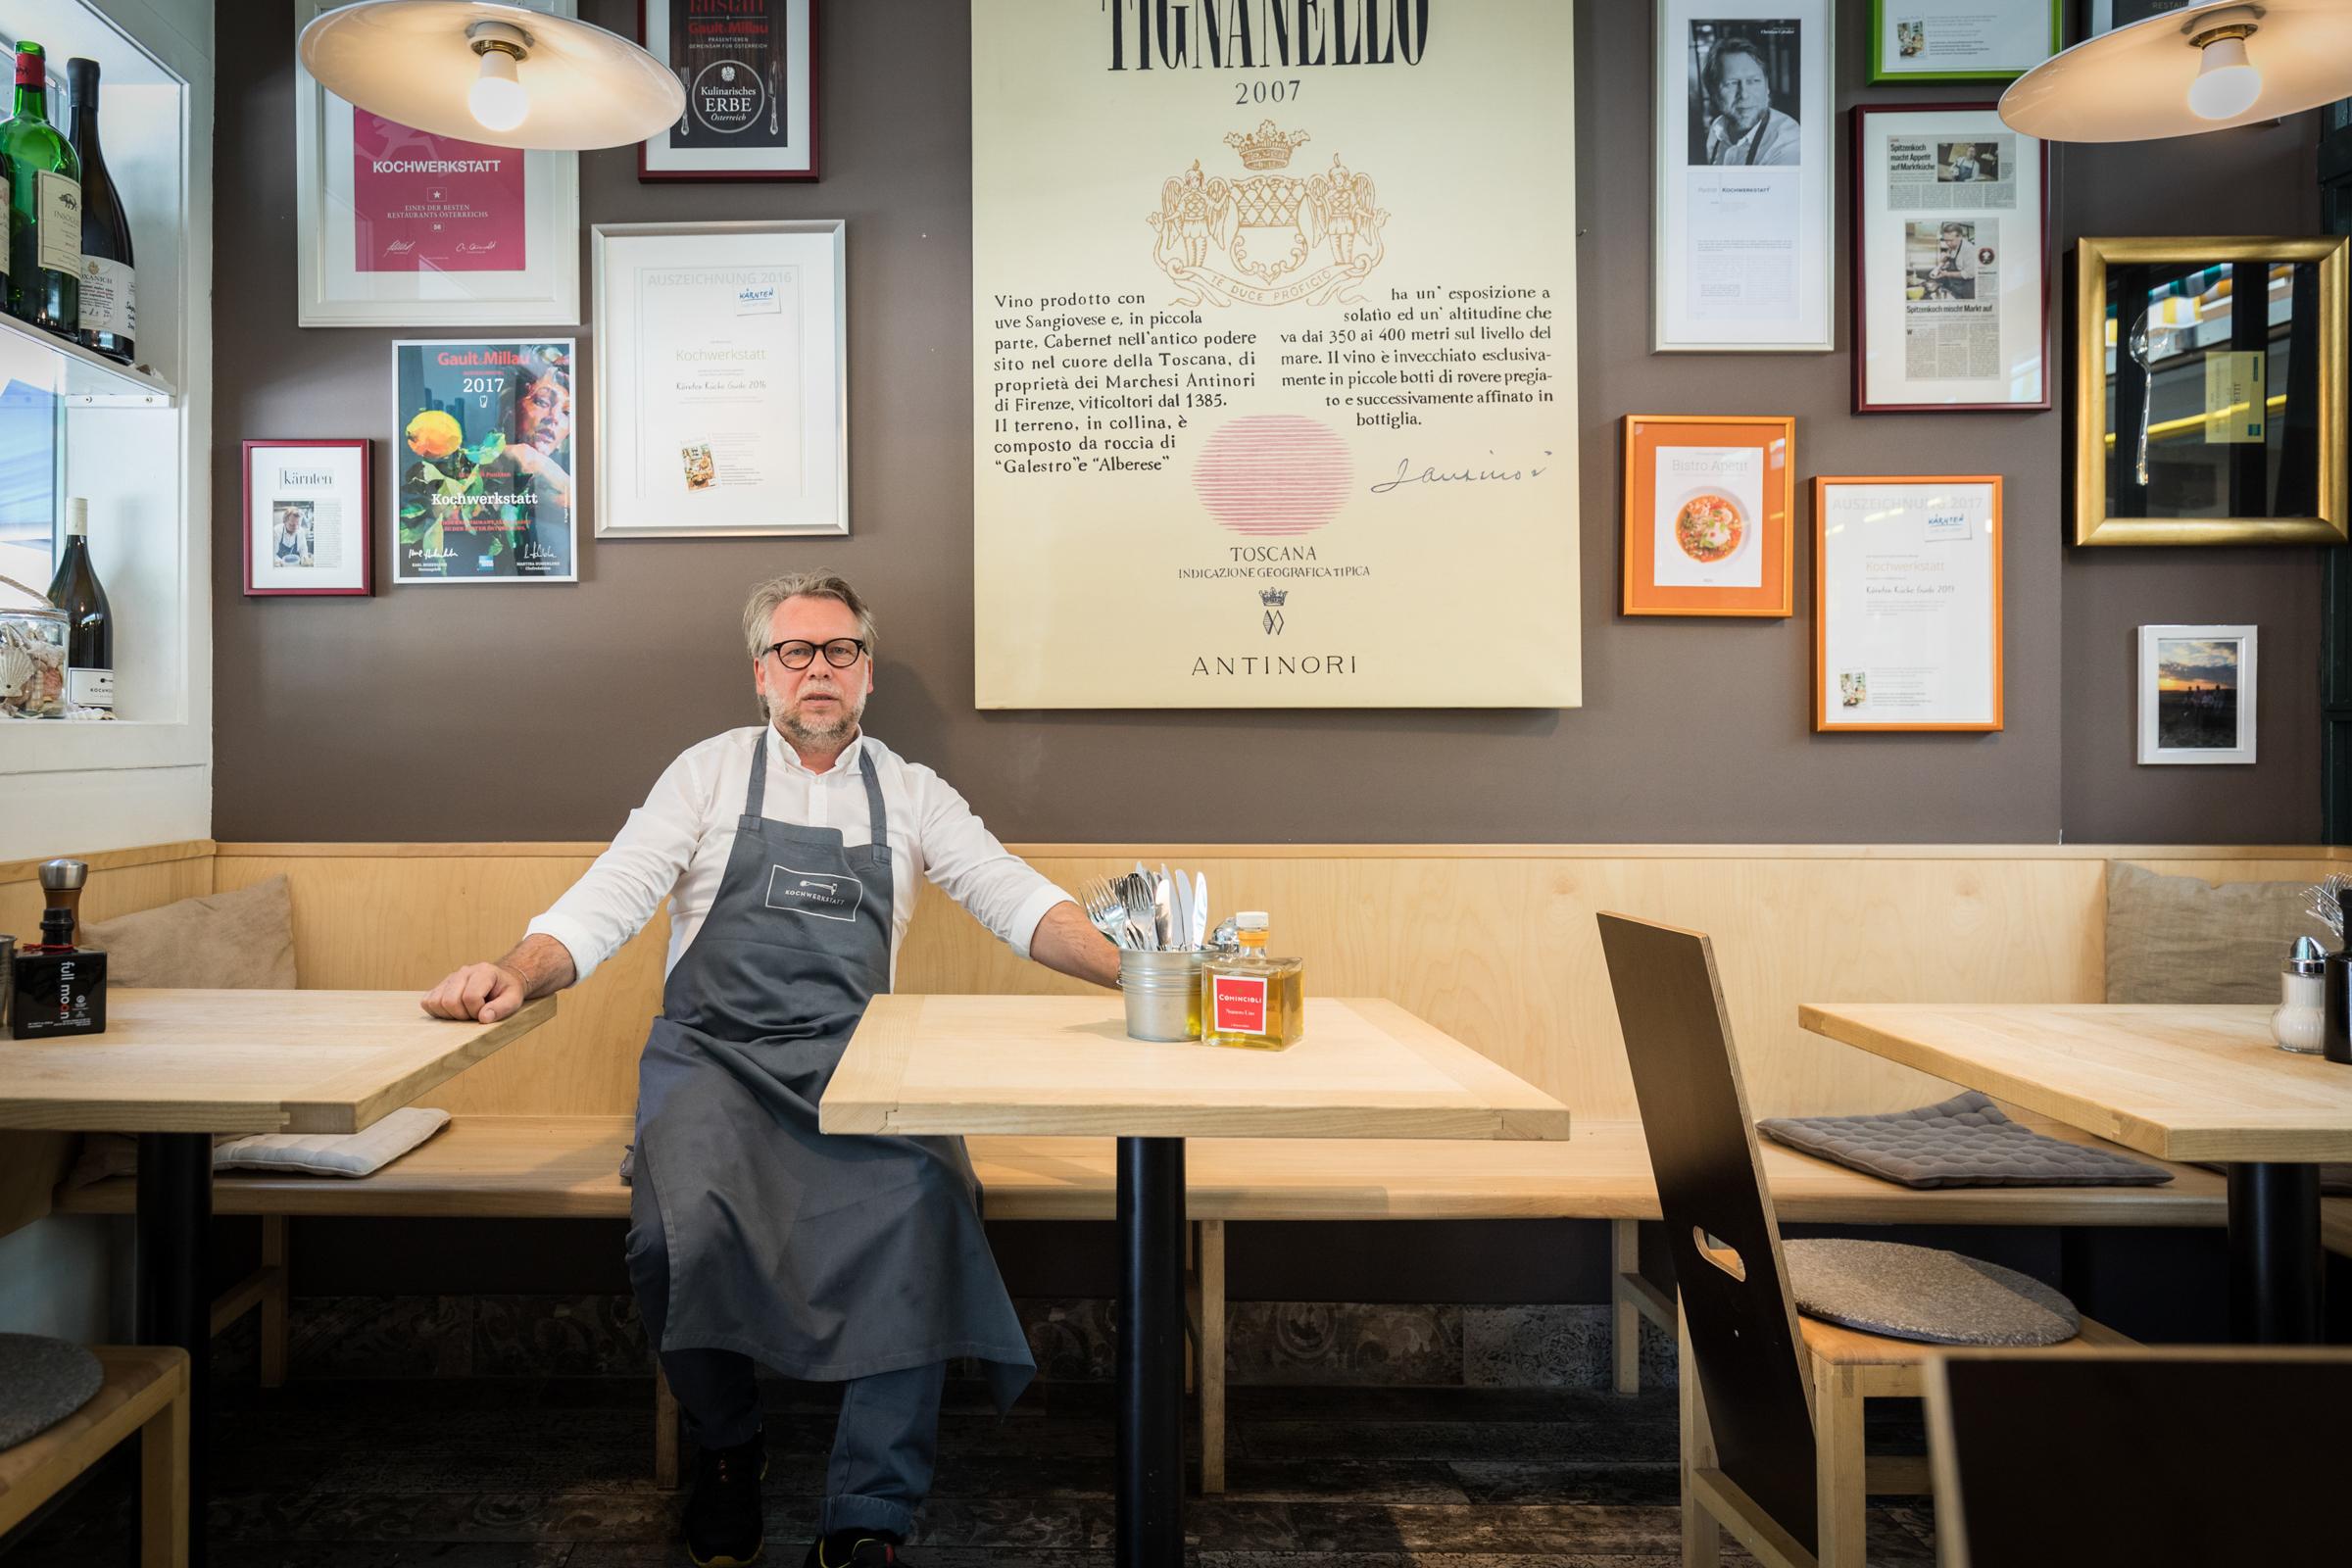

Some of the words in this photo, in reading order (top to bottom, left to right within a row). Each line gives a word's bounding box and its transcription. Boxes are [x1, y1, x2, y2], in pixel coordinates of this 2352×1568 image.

[701, 86, 757, 95] Kulinarisches
[1235, 79, 1301, 106] 2007
[706, 98, 752, 113] ERBE
[372, 160, 501, 173] KOCHWERKSTATT
[1910, 153, 1931, 162] Appetit
[649, 272, 759, 286] AUSZEICHNUNG
[760, 272, 792, 283] 2016
[1210, 275, 1224, 288] TE
[1231, 285, 1263, 302] DUCE
[1273, 270, 1332, 301] PROFICIO
[994, 294, 1034, 309] Vino
[1040, 291, 1111, 311] prodotto
[1117, 294, 1146, 305] con
[1391, 287, 1408, 301] ha
[1447, 284, 1537, 304] esposizione
[1542, 289, 1551, 299] a
[995, 318, 1022, 330] uve
[1025, 313, 1106, 332] Sangiovese
[1129, 312, 1145, 325] in
[1150, 309, 1203, 330] piccola
[1396, 306, 1414, 321] ed
[1448, 305, 1522, 320] altitudine
[1525, 305, 1552, 320] che
[1043, 332, 1112, 349] Cabernet
[1117, 330, 1199, 347] nell'antico
[1203, 329, 1257, 349] podere
[1280, 333, 1298, 344] va
[1301, 329, 1323, 344] dai
[1328, 328, 1356, 345] 350
[1360, 328, 1373, 343] ai
[1378, 327, 1406, 342] 400
[1410, 326, 1450, 341] metri
[1453, 325, 1476, 341] sul
[1481, 325, 1525, 340] livello
[1529, 324, 1551, 340] del
[676, 349, 765, 361] Kochwerkstatt
[993, 357, 1025, 371] sito
[1031, 354, 1055, 370] nel
[1061, 358, 1108, 369] cuore
[1112, 352, 1153, 368] della
[1238, 350, 1255, 367] di
[1281, 354, 1323, 366] mare.
[1327, 349, 1340, 365] Il
[1342, 349, 1376, 365] vino
[1381, 350, 1391, 364] è
[1393, 347, 1477, 364] invecchiato
[1482, 347, 1552, 362] esclusiva-
[463, 378, 504, 393] 2017
[994, 375, 1070, 398] proprietà
[1074, 374, 1099, 389] dei
[1105, 372, 1179, 389] Marchesi
[1186, 371, 1255, 388] Antinori
[1281, 373, 1327, 387] mente
[1329, 371, 1344, 386] in
[1348, 369, 1398, 390] piccole
[1399, 368, 1435, 384] botti
[1438, 368, 1453, 384] di
[1456, 371, 1502, 383] rovere
[1503, 367, 1553, 387] pregia-
[994, 397, 1009, 413] di
[1015, 397, 1075, 413] Firenze,
[1078, 394, 1153, 410] viticoltori
[1157, 392, 1180, 409] dal
[1186, 392, 1228, 409] 1385.
[1325, 396, 1341, 407] to
[1345, 397, 1354, 406] e
[1356, 390, 1474, 407] successivamente
[1476, 389, 1534, 404] affinato
[1538, 389, 1554, 403] in
[995, 417, 1007, 433] Il
[1013, 419, 1079, 433] terreno,
[1087, 415, 1102, 431] in
[1108, 415, 1172, 430] collina,
[1177, 414, 1188, 429] è
[1355, 410, 1422, 430] bottiglia.
[994, 439, 1072, 457] composto
[1078, 435, 1099, 451] da
[1103, 435, 1154, 451] roccia
[1159, 433, 1176, 449] di
[1672, 460, 1708, 470] Bistro
[284, 470, 332, 485] kärnten
[431, 492, 538, 506] Kochwerkstatt
[1229, 545, 1317, 563] TOSCANA
[1178, 567, 1255, 579] INDICAZIONE
[1257, 566, 1332, 578] GEOGRAFICA
[1333, 565, 1371, 577] TIPICA
[1866, 562, 1944, 572] Kochwerkstatt
[1192, 656, 1355, 676] ANTINORI
[785, 890, 846, 906] KOCHWERKSTATT
[60, 961, 75, 981] full
[60, 985, 72, 1019] moon
[1219, 994, 1262, 1004] COMINCIOLI
